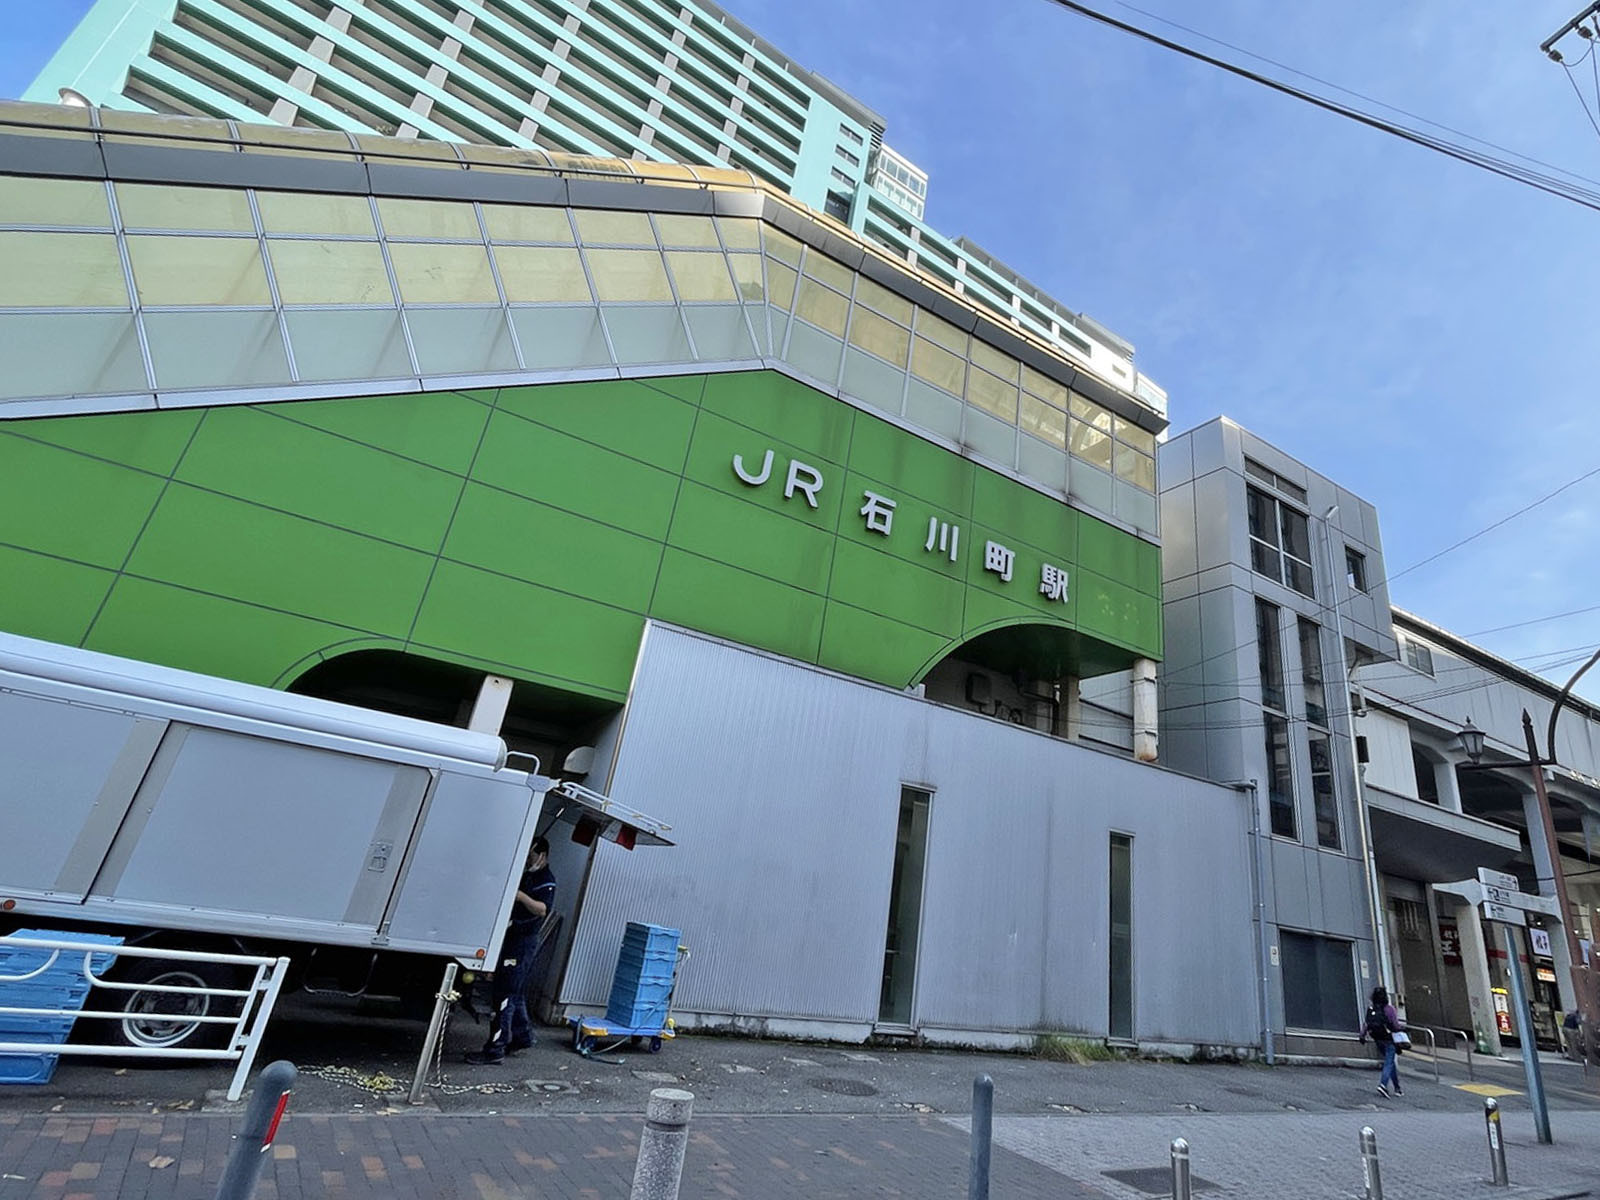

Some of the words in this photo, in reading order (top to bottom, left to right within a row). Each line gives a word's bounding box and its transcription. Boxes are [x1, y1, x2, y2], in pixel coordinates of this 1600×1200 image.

[733, 450, 824, 508] JR
[859, 489, 1069, 603] 石川町駅
